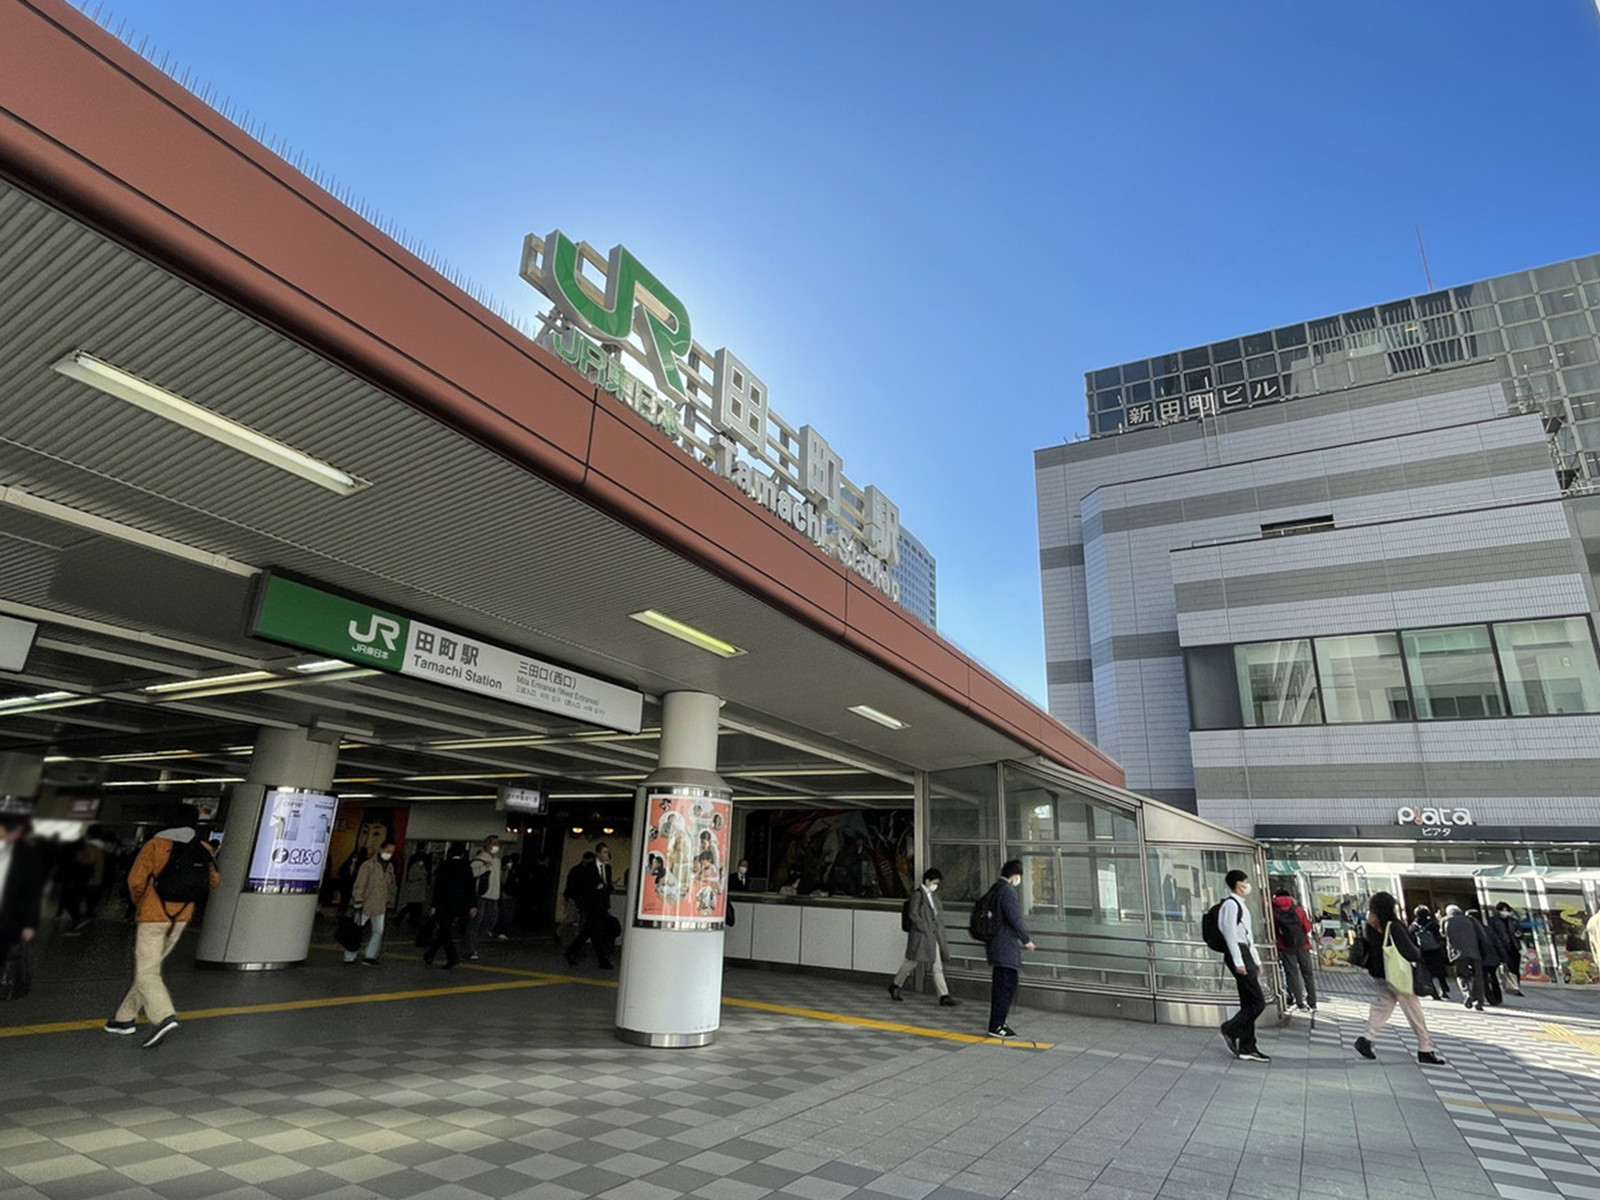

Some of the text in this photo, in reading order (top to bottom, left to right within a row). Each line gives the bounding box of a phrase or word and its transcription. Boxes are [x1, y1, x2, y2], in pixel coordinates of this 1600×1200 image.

[546, 229, 692, 403] JR
[1127, 380, 1279, 426] 新田町ビル
[712, 347, 900, 567] 田町駅
[711, 434, 901, 604] Tamachi Station
[348, 614, 400, 651] JR
[414, 629, 480, 668] 田町駅
[414, 654, 503, 690] Tamachi Station
[518, 660, 577, 690] 三田口(西口)
[288, 848, 323, 866] RISO
